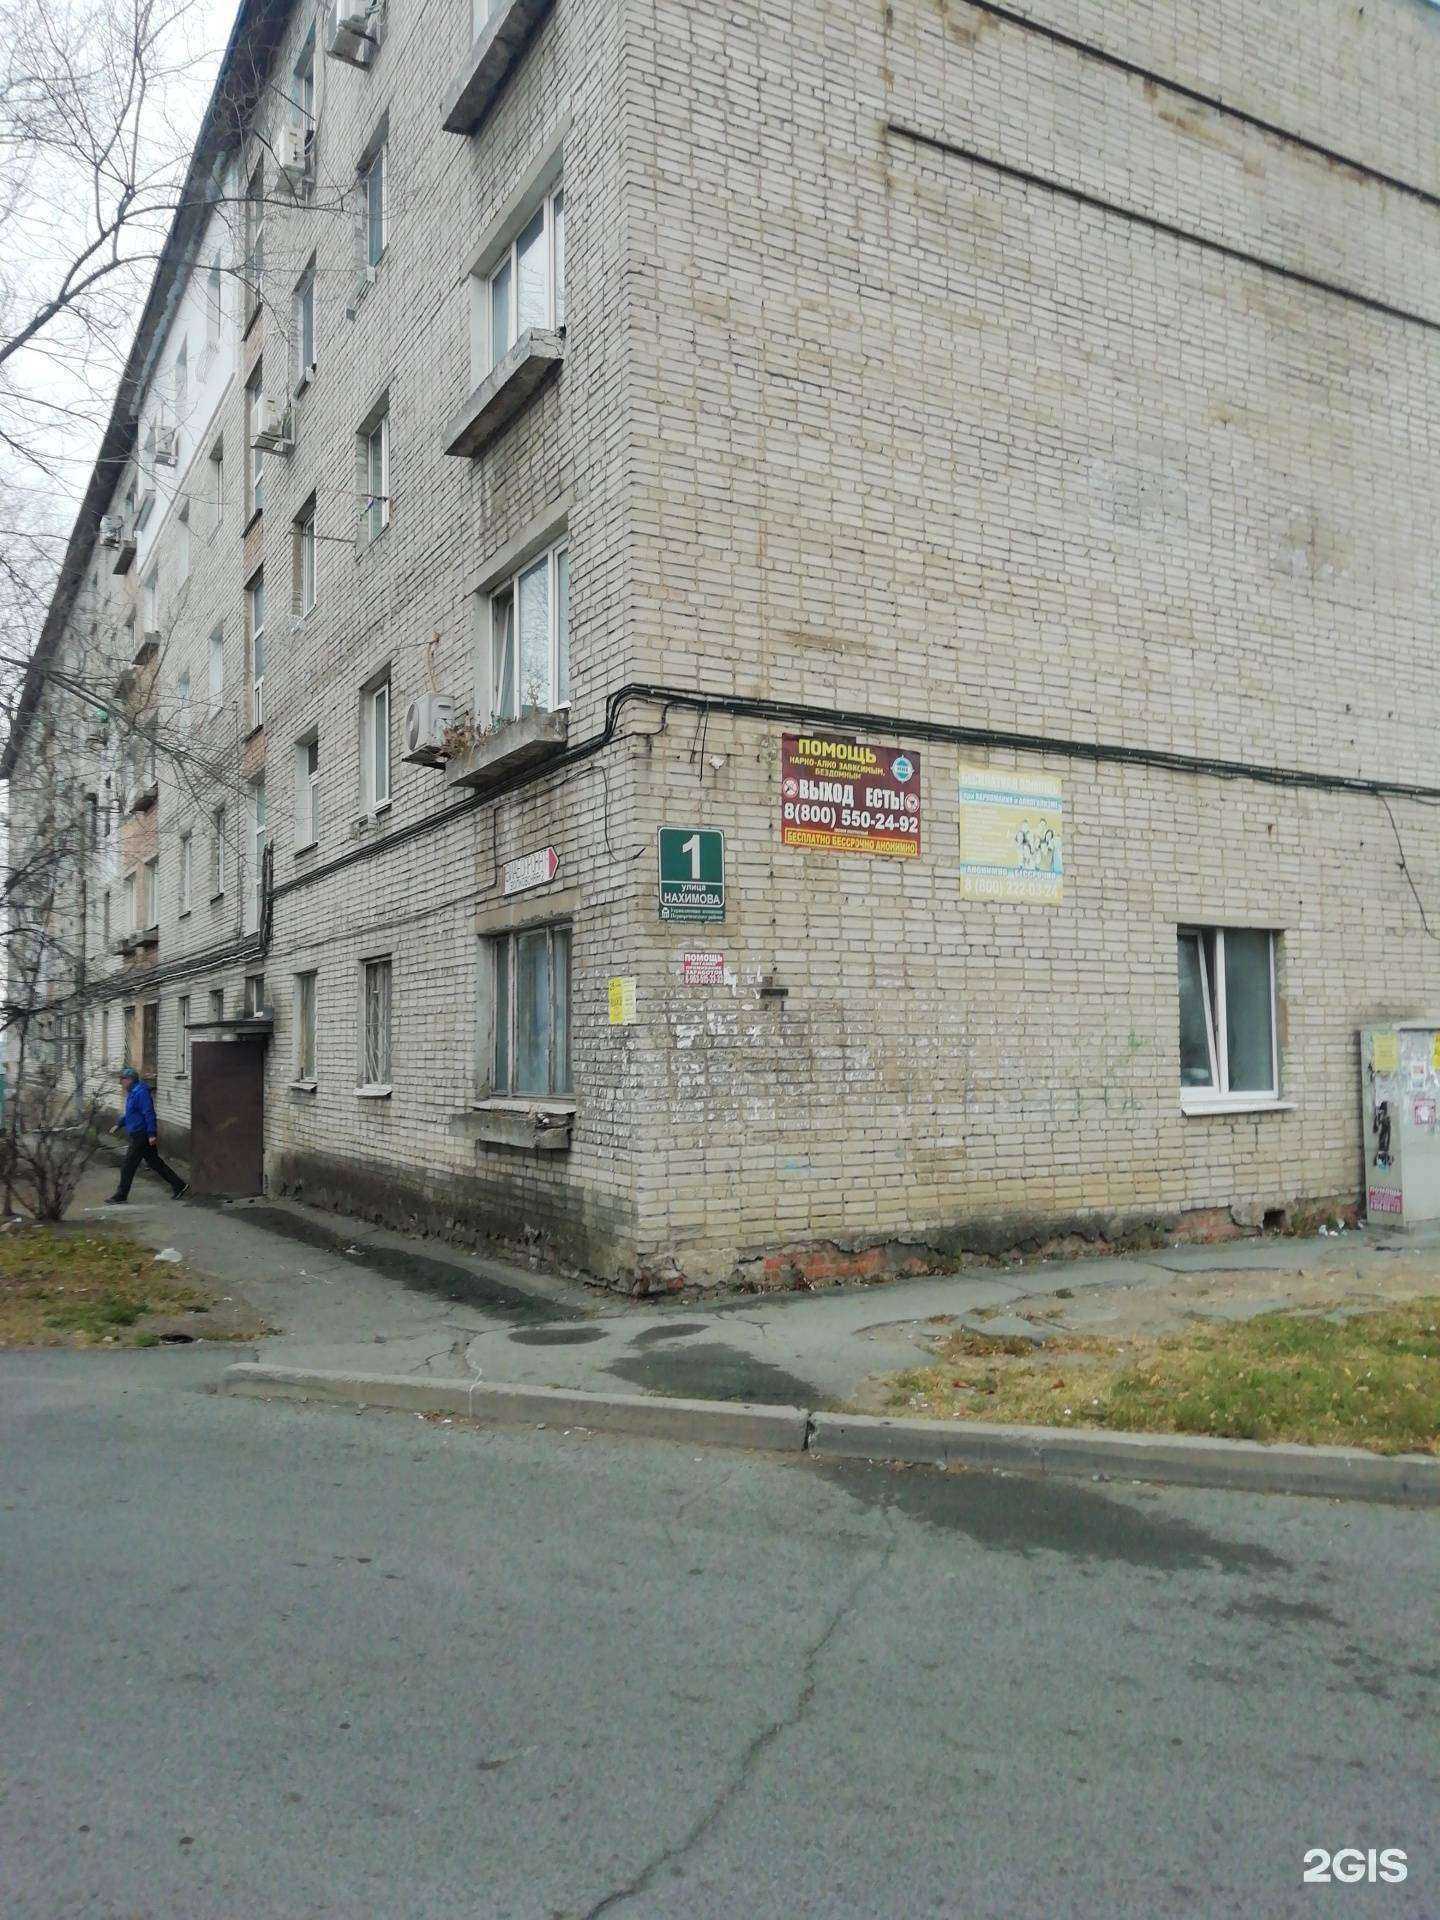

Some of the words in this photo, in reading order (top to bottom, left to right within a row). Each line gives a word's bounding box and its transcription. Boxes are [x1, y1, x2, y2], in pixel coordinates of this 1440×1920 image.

[790, 756, 836, 769] НАРКО-АЛКО
[798, 739, 876, 764] ПОМОЩЬ
[799, 779, 854, 807] ВЫХОД
[866, 787, 904, 811] ЕСТЬ!
[784, 802, 836, 828] 8(800)
[841, 810, 918, 833] 550-24-92
[787, 831, 831, 846] БЕСПЛАТНО
[832, 835, 874, 850] БЕССРОЧНО
[876, 840, 916, 853] АНОНИМНО
[682, 834, 701, 880] 1
[664, 893, 720, 905] НАХИМОВА
[681, 884, 706, 892] улица
[685, 953, 723, 962] ПОМОЩЬ
